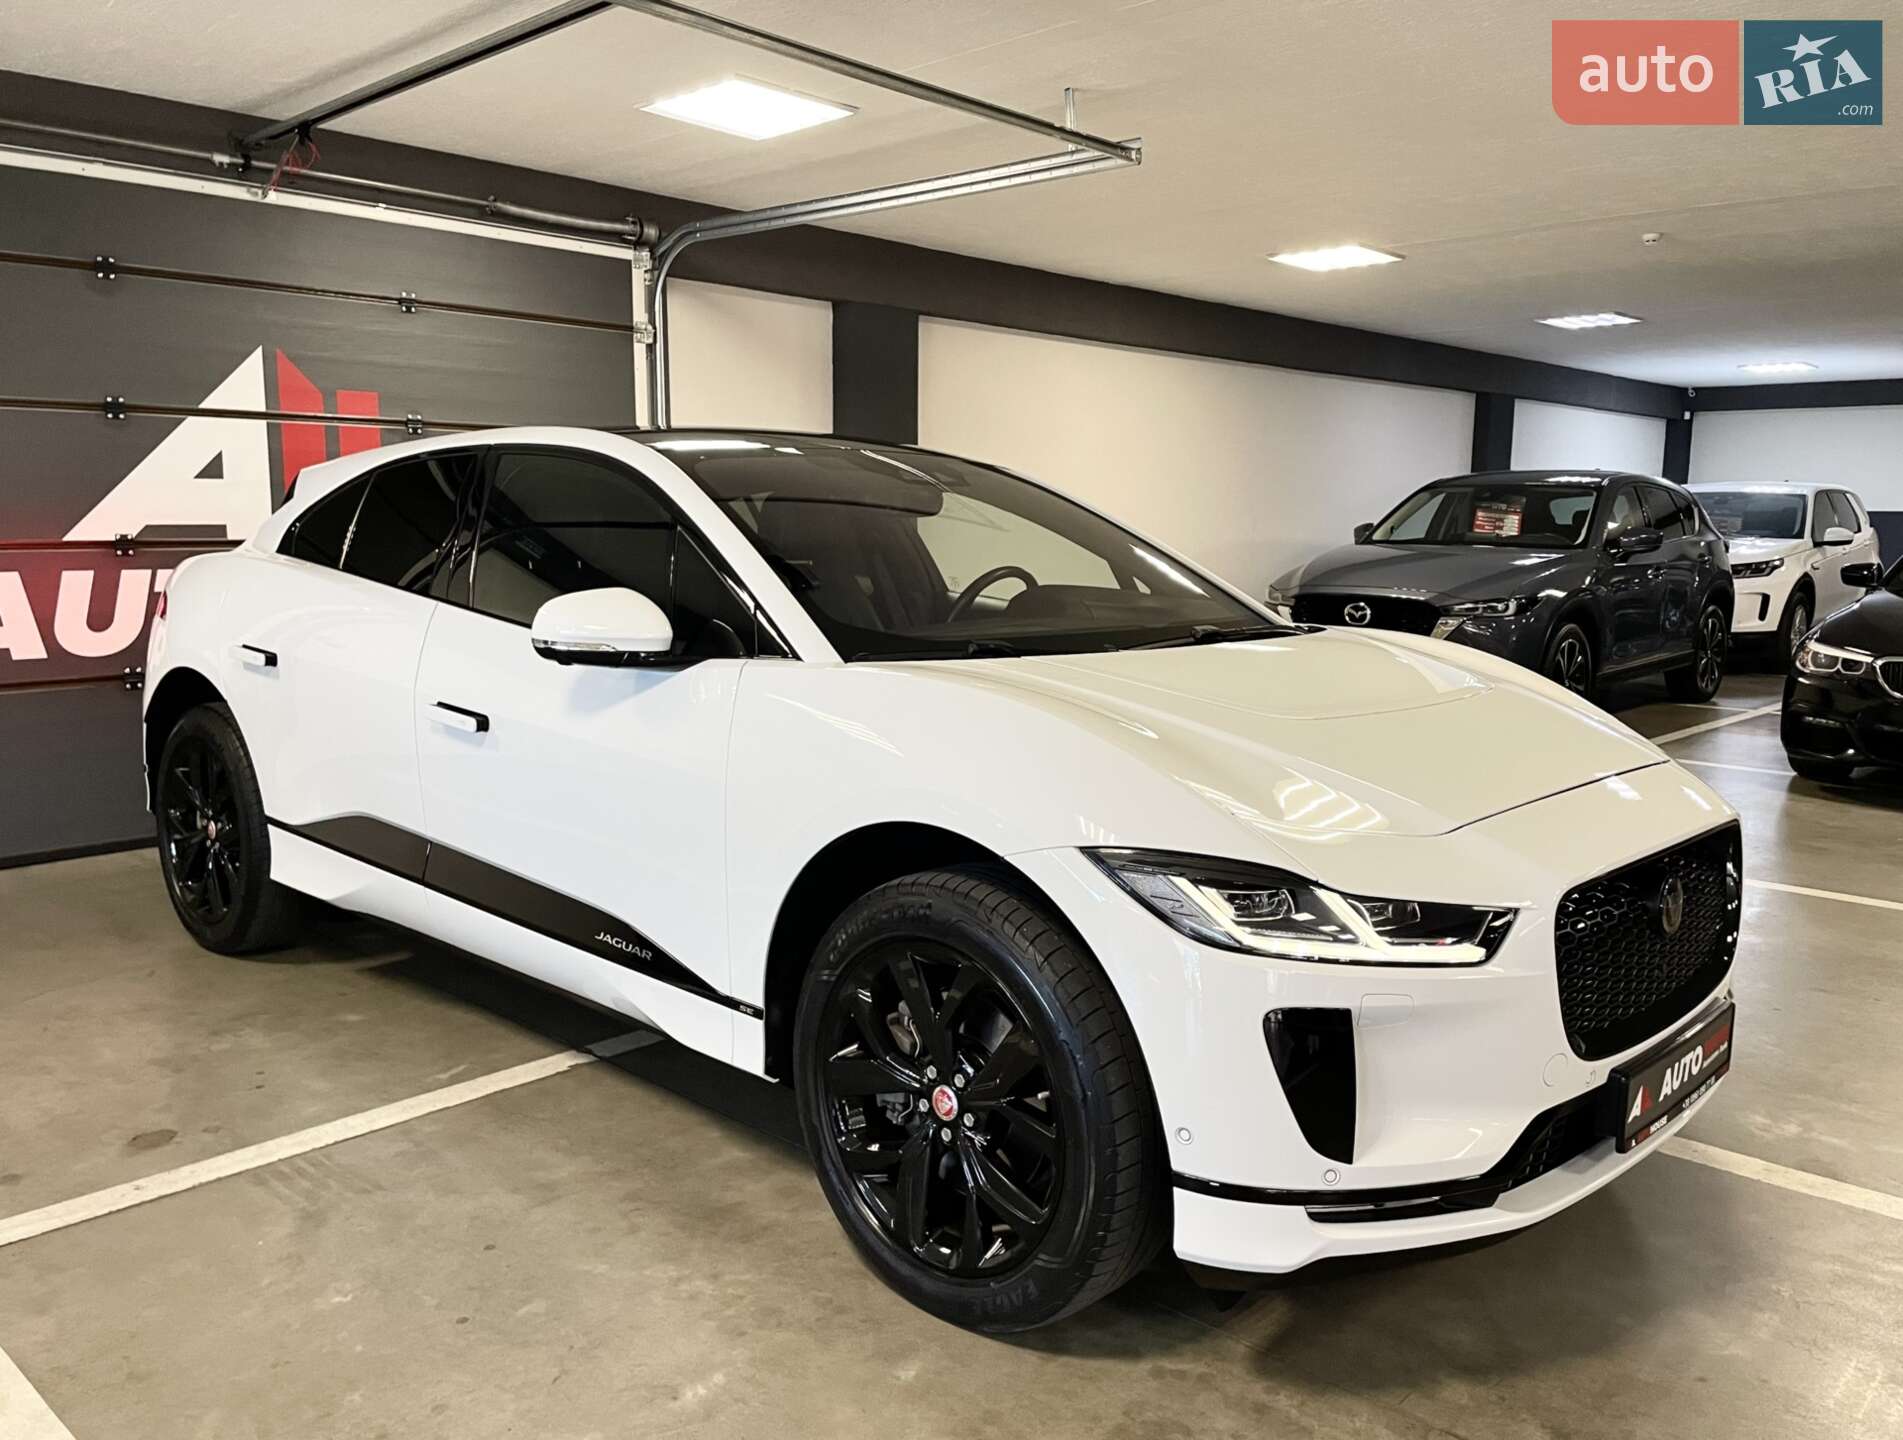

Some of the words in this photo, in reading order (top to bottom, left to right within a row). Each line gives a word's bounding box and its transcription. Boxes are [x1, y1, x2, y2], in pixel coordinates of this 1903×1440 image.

[0, 569, 174, 660] AU
[595, 931, 652, 961] JAGUAR
[739, 1005, 754, 1016] SE
[1659, 1045, 1703, 1102] AUTO
